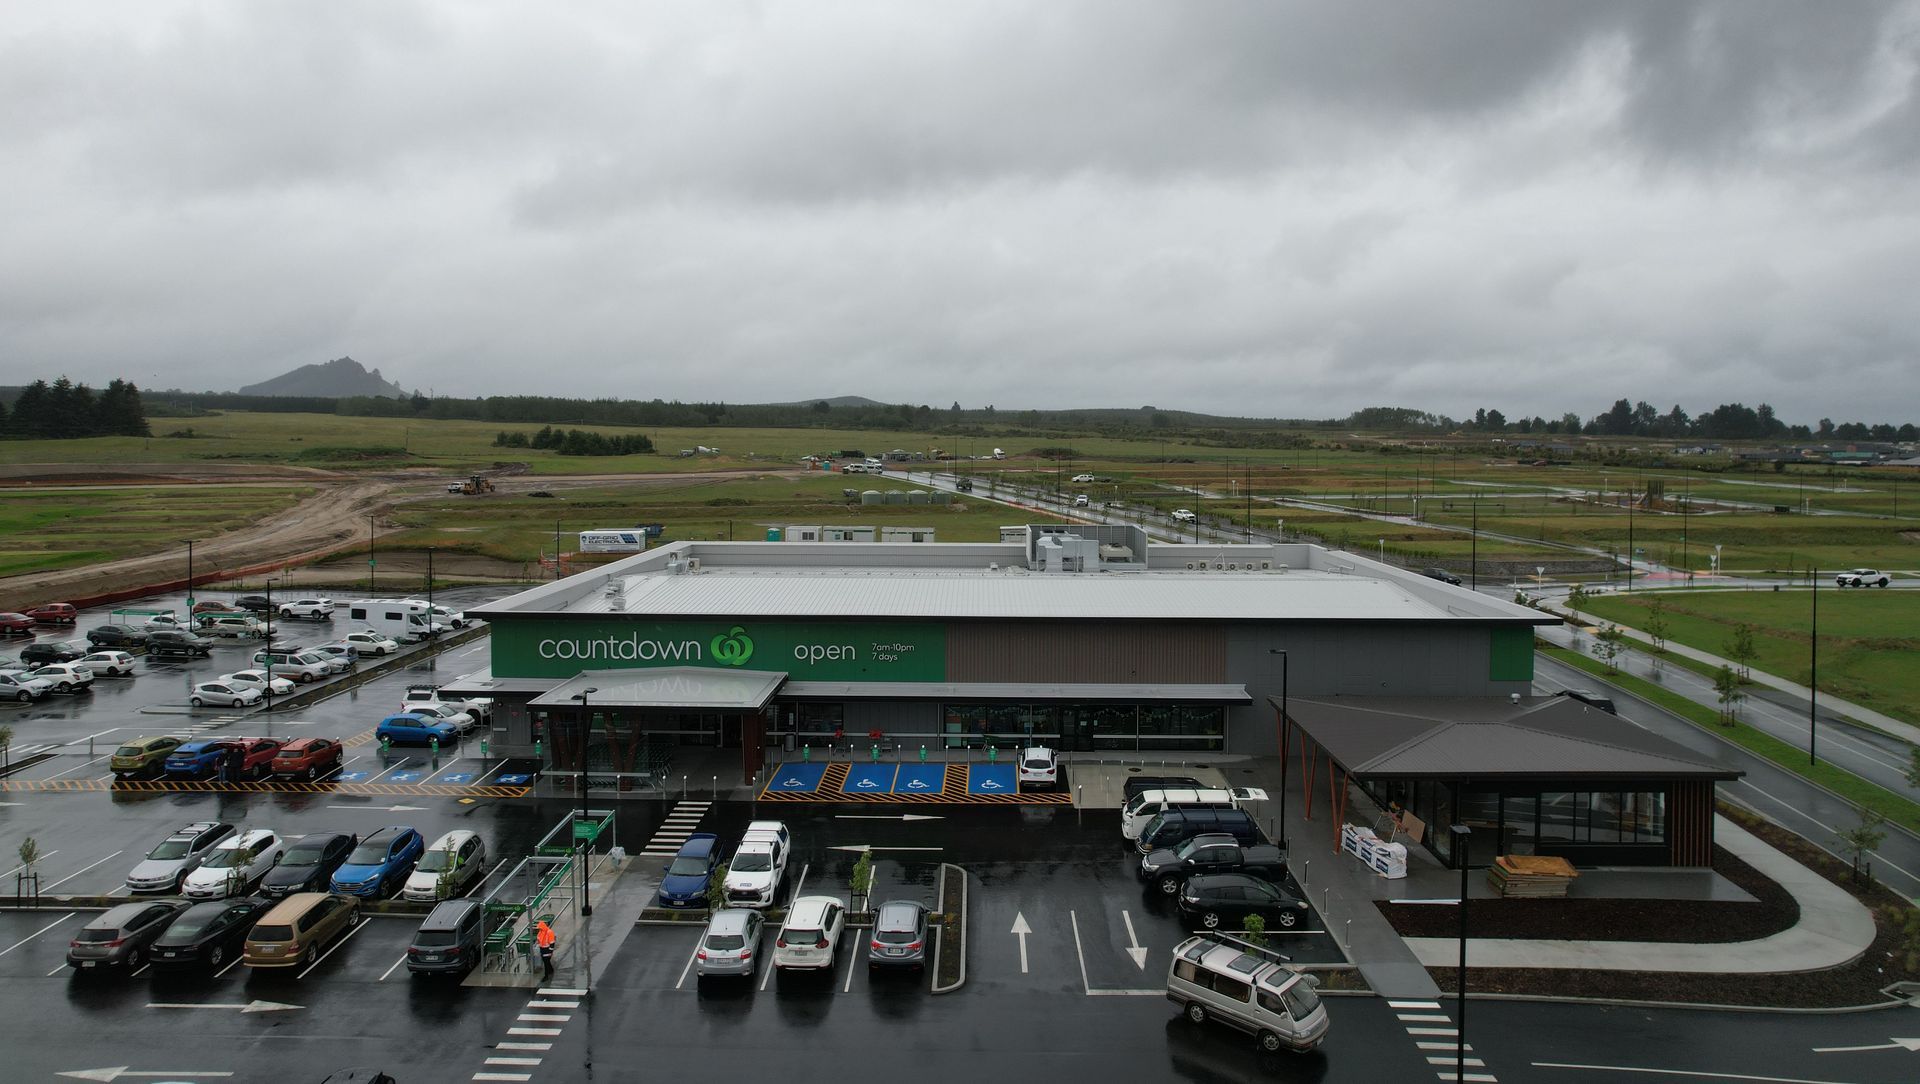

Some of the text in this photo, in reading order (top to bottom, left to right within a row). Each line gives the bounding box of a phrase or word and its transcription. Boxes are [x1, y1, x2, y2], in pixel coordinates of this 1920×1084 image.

[538, 631, 702, 661] countdown
[793, 642, 856, 665] open
[871, 643, 915, 653] 7am-10pm
[871, 652, 898, 662] 7 days
